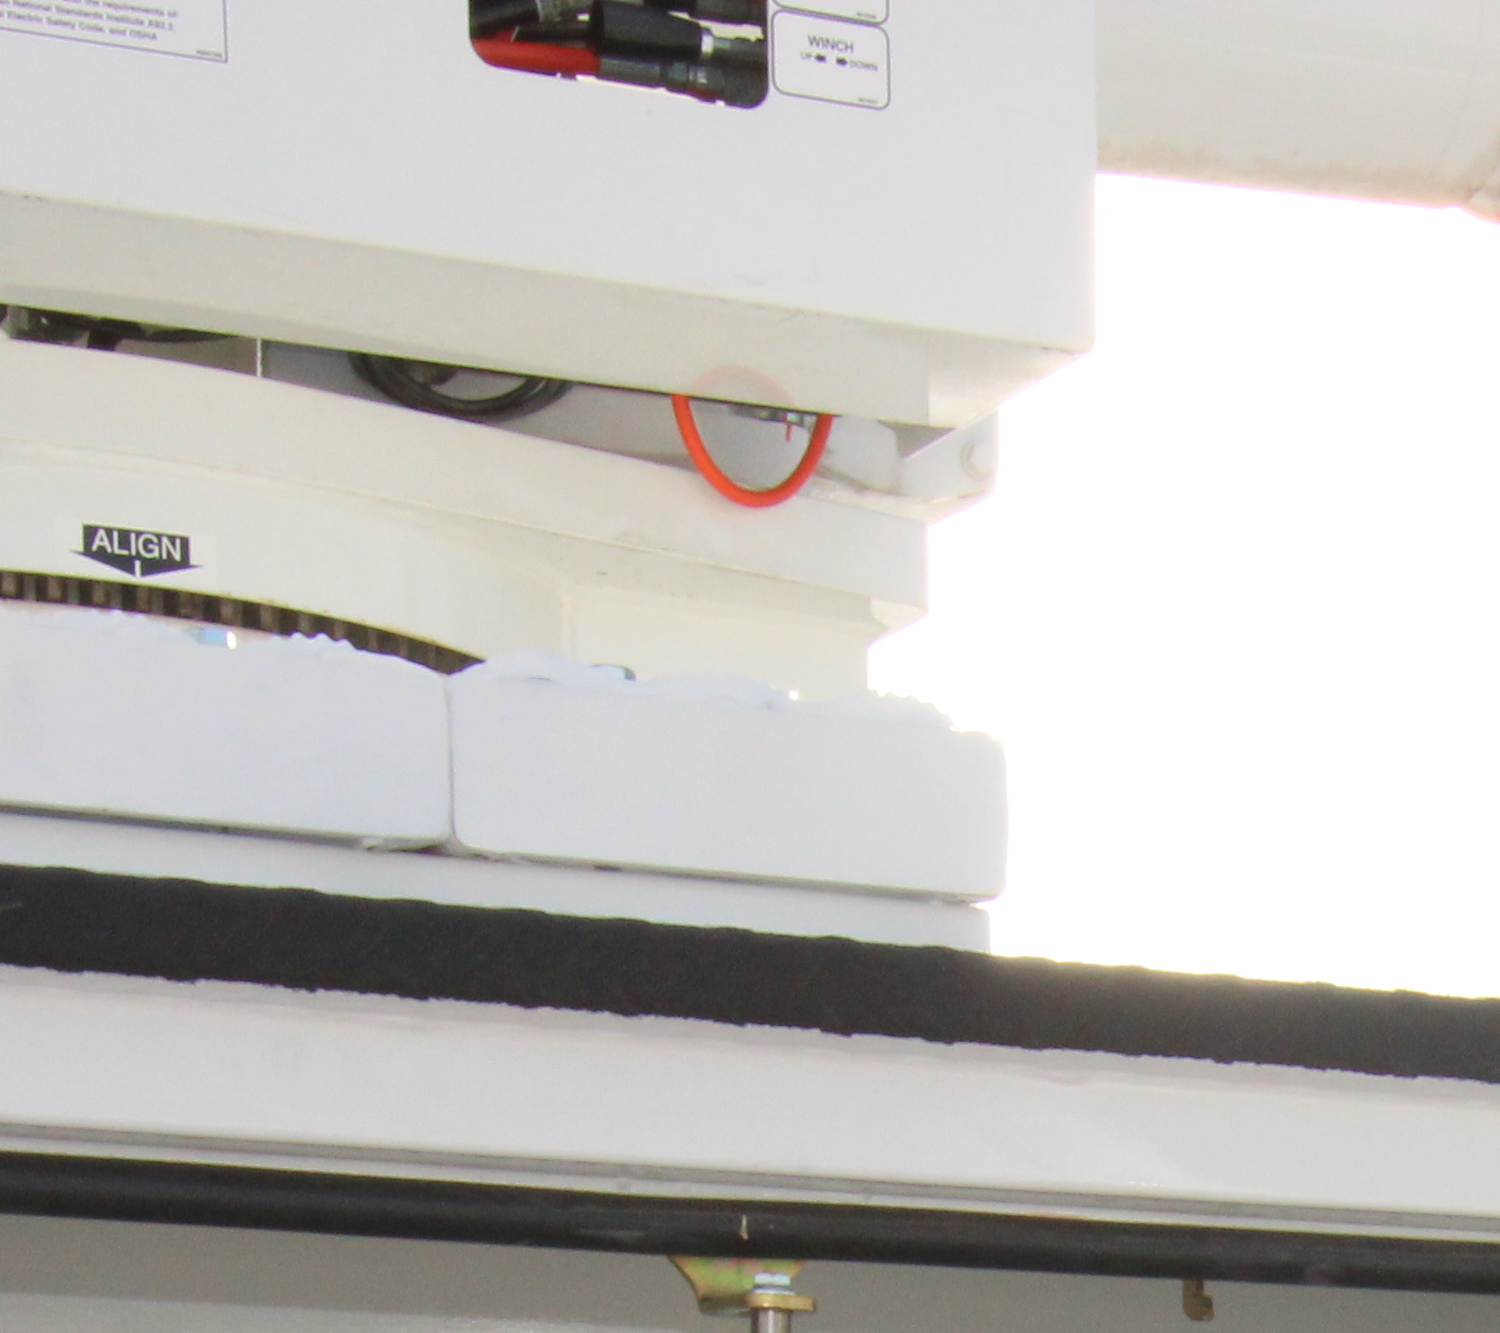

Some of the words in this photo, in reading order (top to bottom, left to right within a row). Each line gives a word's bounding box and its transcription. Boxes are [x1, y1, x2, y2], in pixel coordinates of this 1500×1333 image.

[54, 5, 103, 19] Standards
[6, 10, 44, 24] Electric
[46, 16, 76, 30] Safety
[109, 27, 127, 37] and
[129, 29, 159, 41] OSHA
[808, 35, 854, 53] WINCH
[801, 51, 812, 59] UP
[850, 60, 878, 71] DOWN
[90, 528, 181, 562] ALIGN
